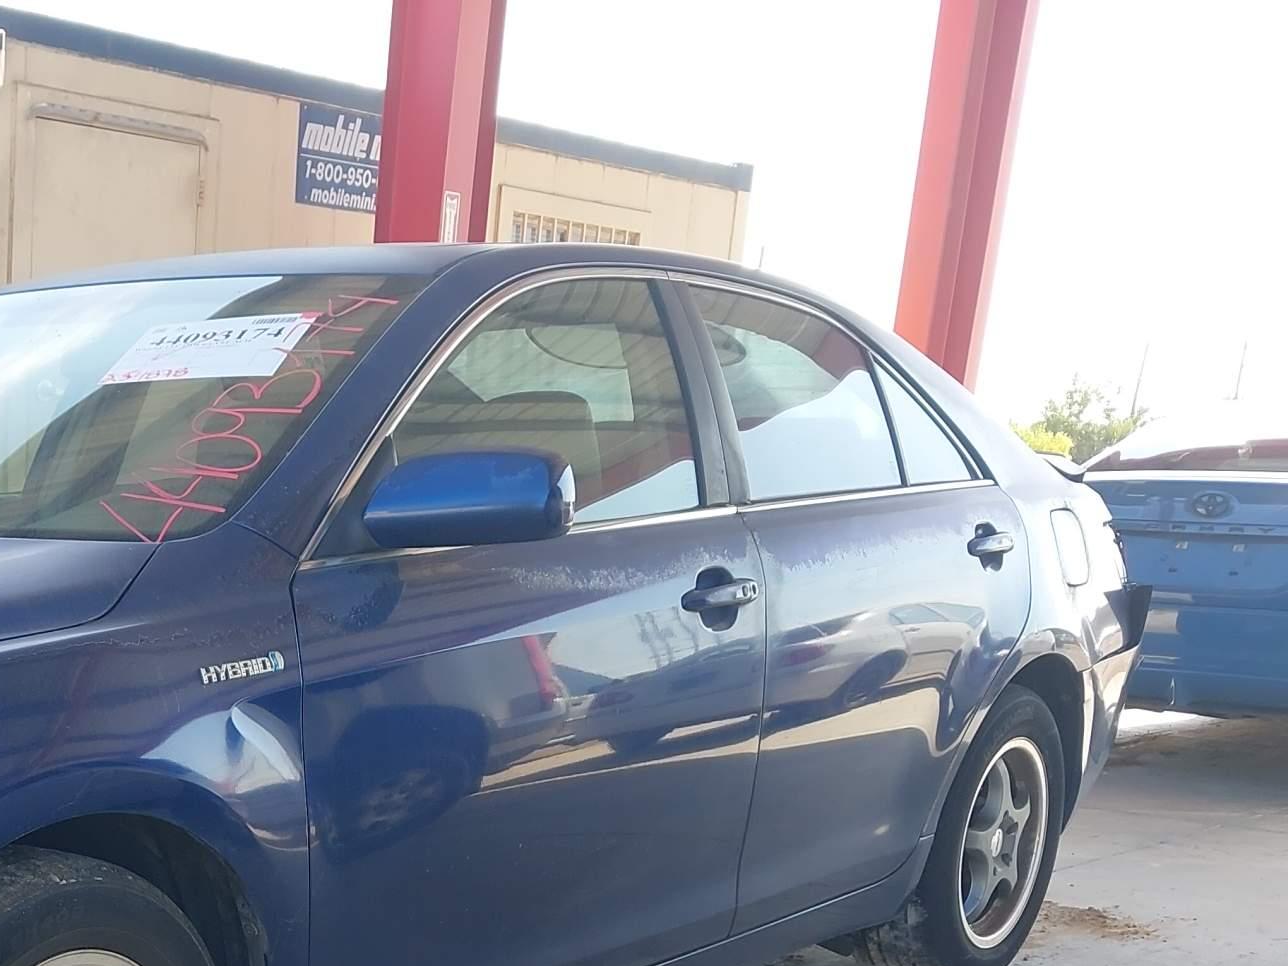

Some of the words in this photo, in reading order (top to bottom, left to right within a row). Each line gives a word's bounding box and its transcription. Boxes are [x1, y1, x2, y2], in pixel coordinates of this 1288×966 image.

[302, 115, 370, 159] mobile
[305, 160, 378, 188] 1-800-950-
[150, 326, 286, 346] 44093174
[199, 656, 274, 685] HYBRID
